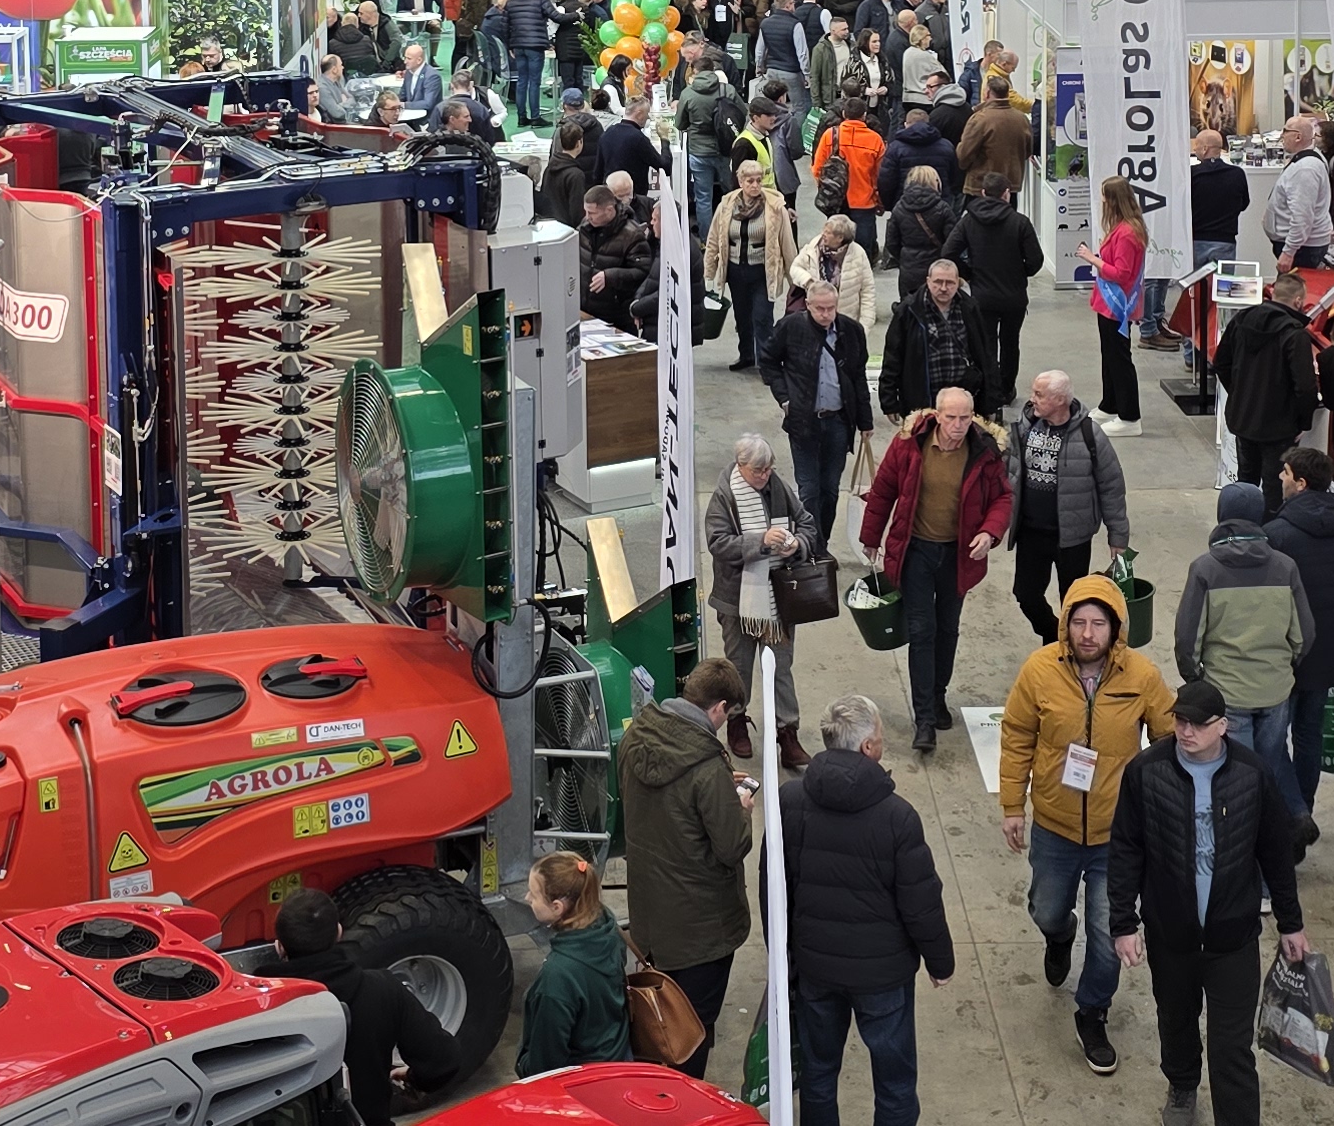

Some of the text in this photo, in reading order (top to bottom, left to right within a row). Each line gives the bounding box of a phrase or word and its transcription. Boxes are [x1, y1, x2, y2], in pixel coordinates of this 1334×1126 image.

[79, 48, 133, 60] SZCZĘŚCIA
[323, 722, 362, 734] DAN-TECH
[204, 755, 336, 803] AGROLA
